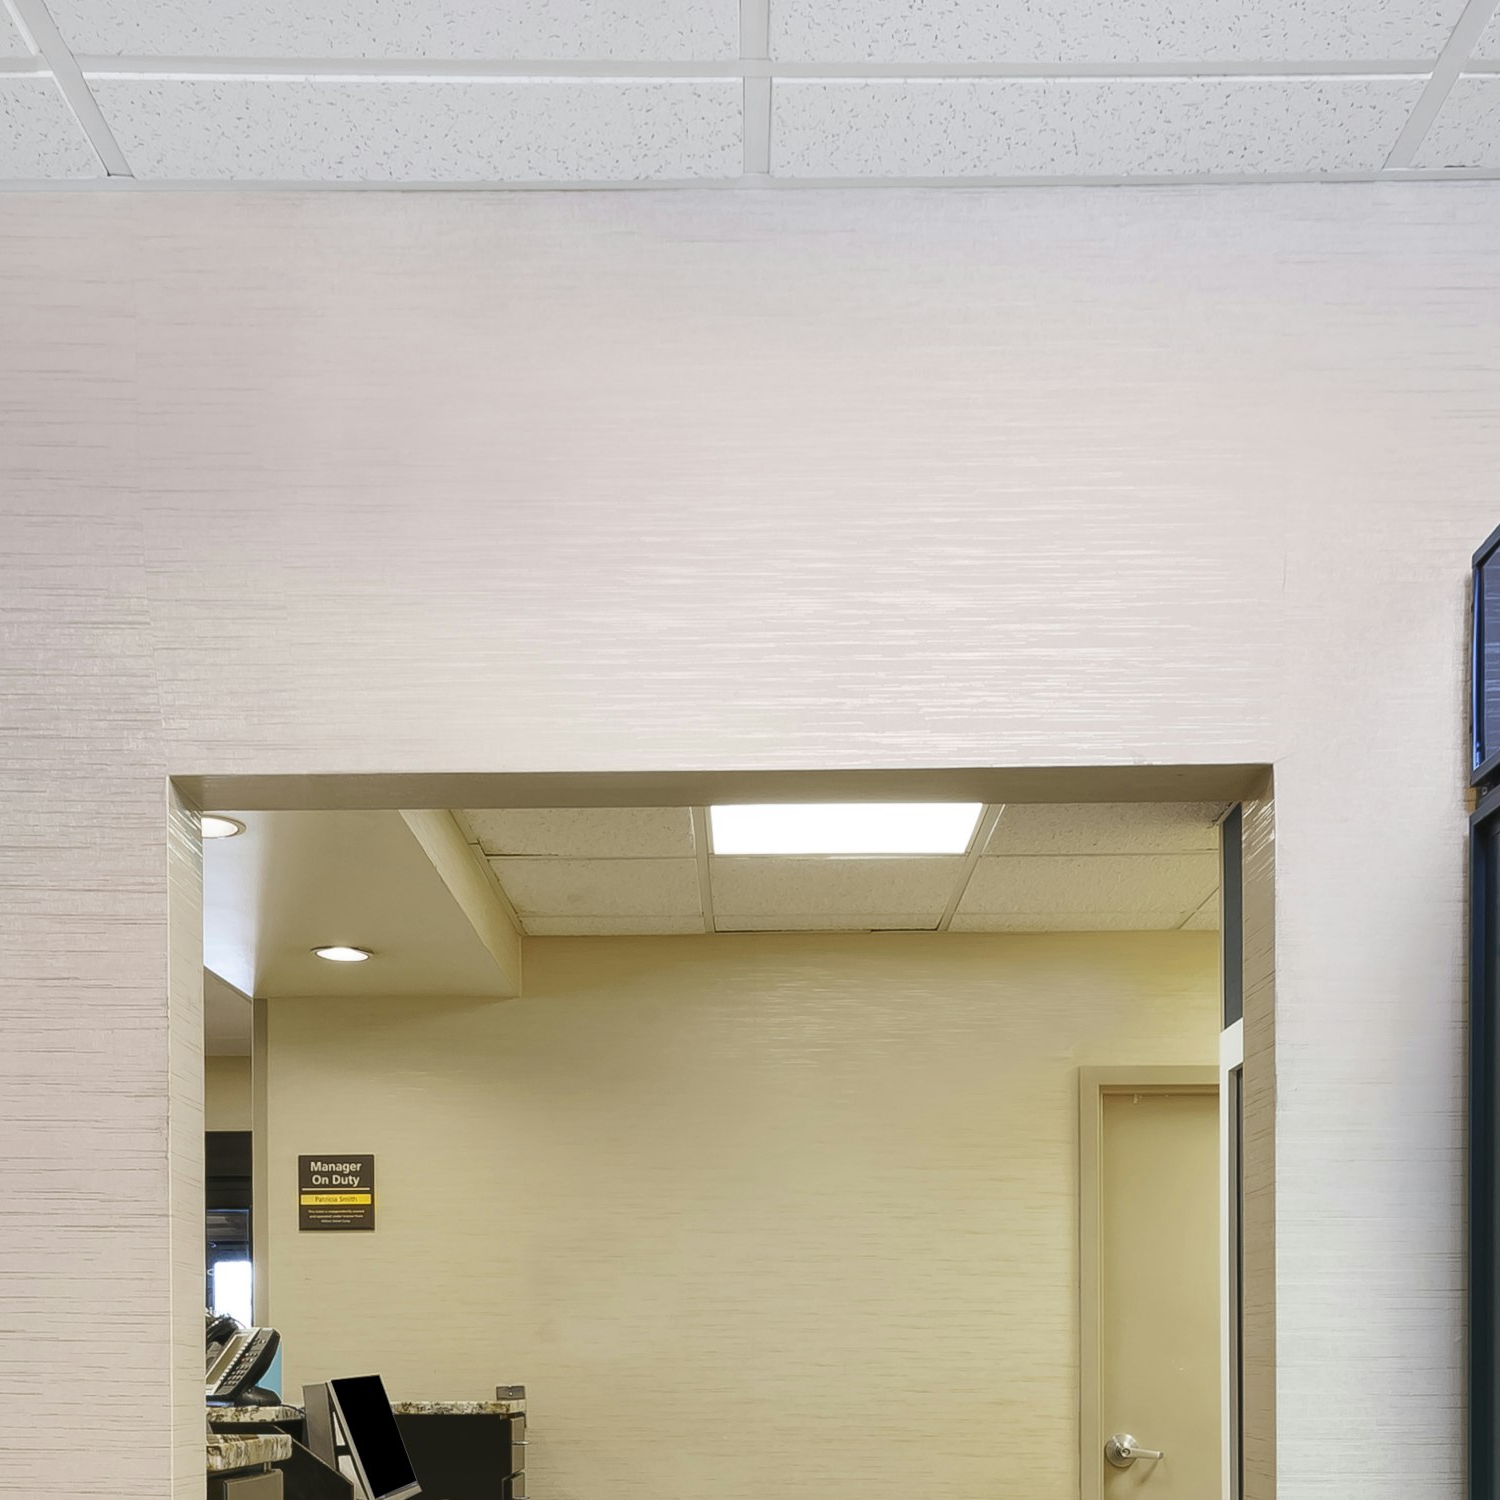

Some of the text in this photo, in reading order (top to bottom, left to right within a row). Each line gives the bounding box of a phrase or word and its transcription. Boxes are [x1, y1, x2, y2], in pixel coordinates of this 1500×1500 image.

[310, 1161, 362, 1174] Manager
[312, 1174, 360, 1187] On Duty
